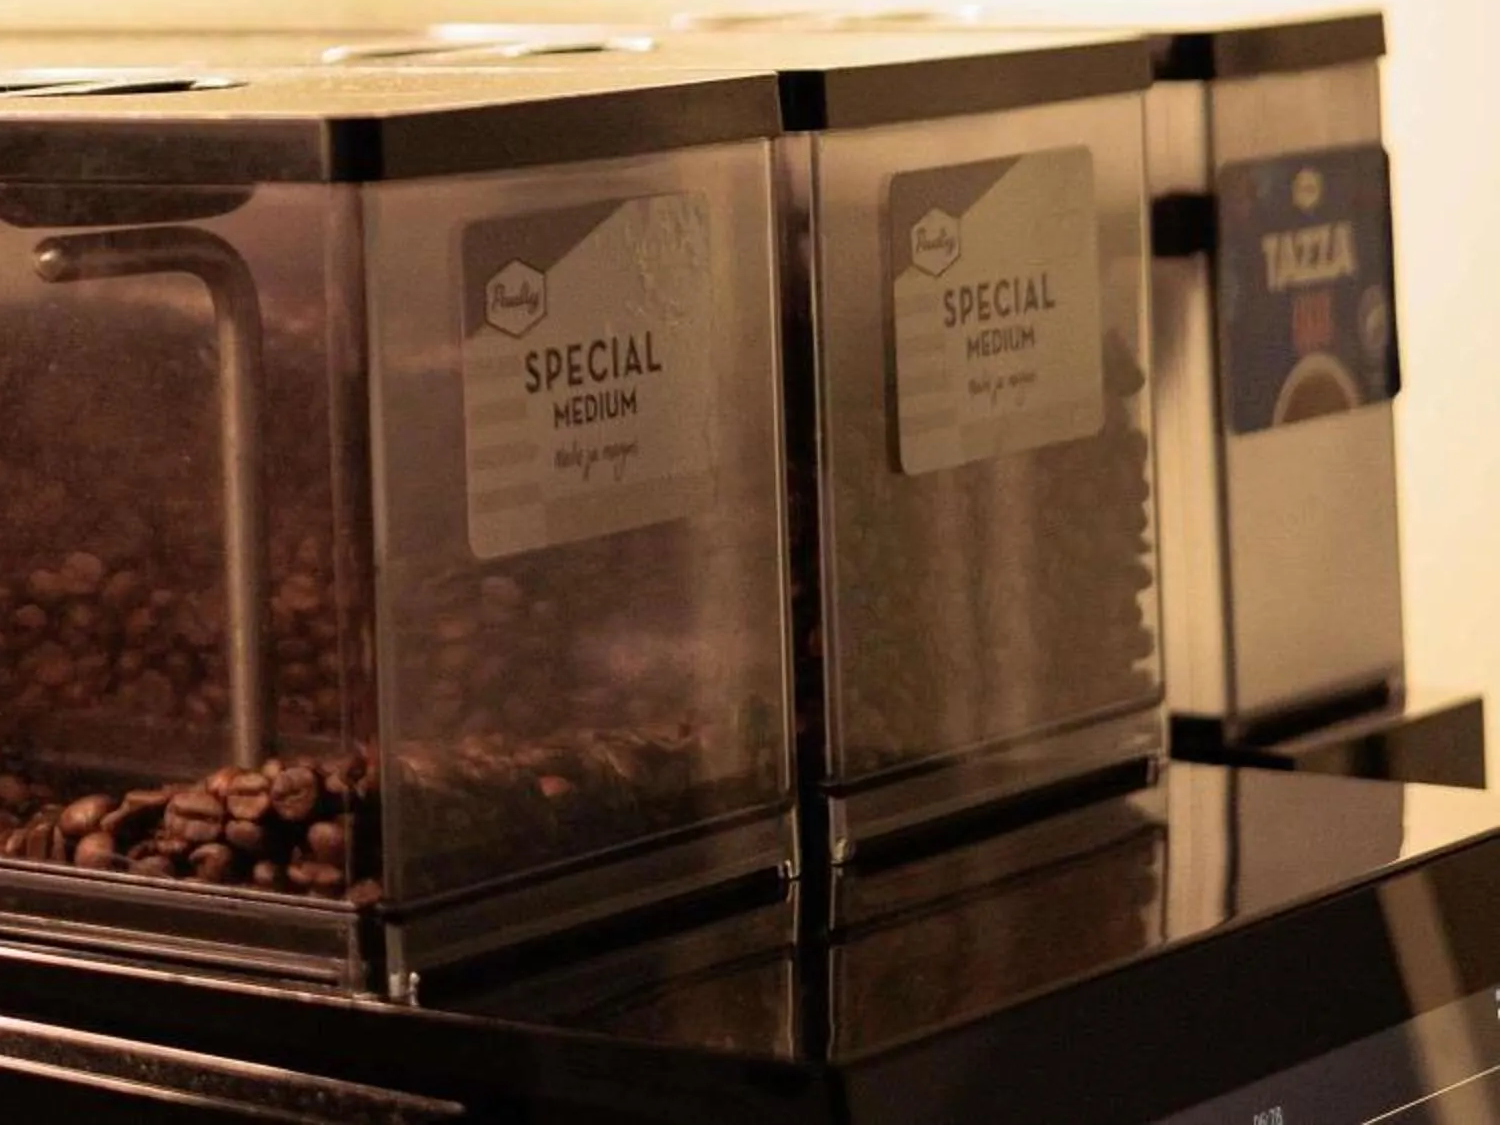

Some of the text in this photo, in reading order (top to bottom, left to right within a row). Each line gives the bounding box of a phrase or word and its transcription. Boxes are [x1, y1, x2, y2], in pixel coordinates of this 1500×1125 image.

[943, 272, 1056, 328] SPECIAL
[524, 331, 663, 394] SPECIAL
[966, 326, 1036, 359] MEDIUM
[553, 388, 638, 428] MEDIUM
